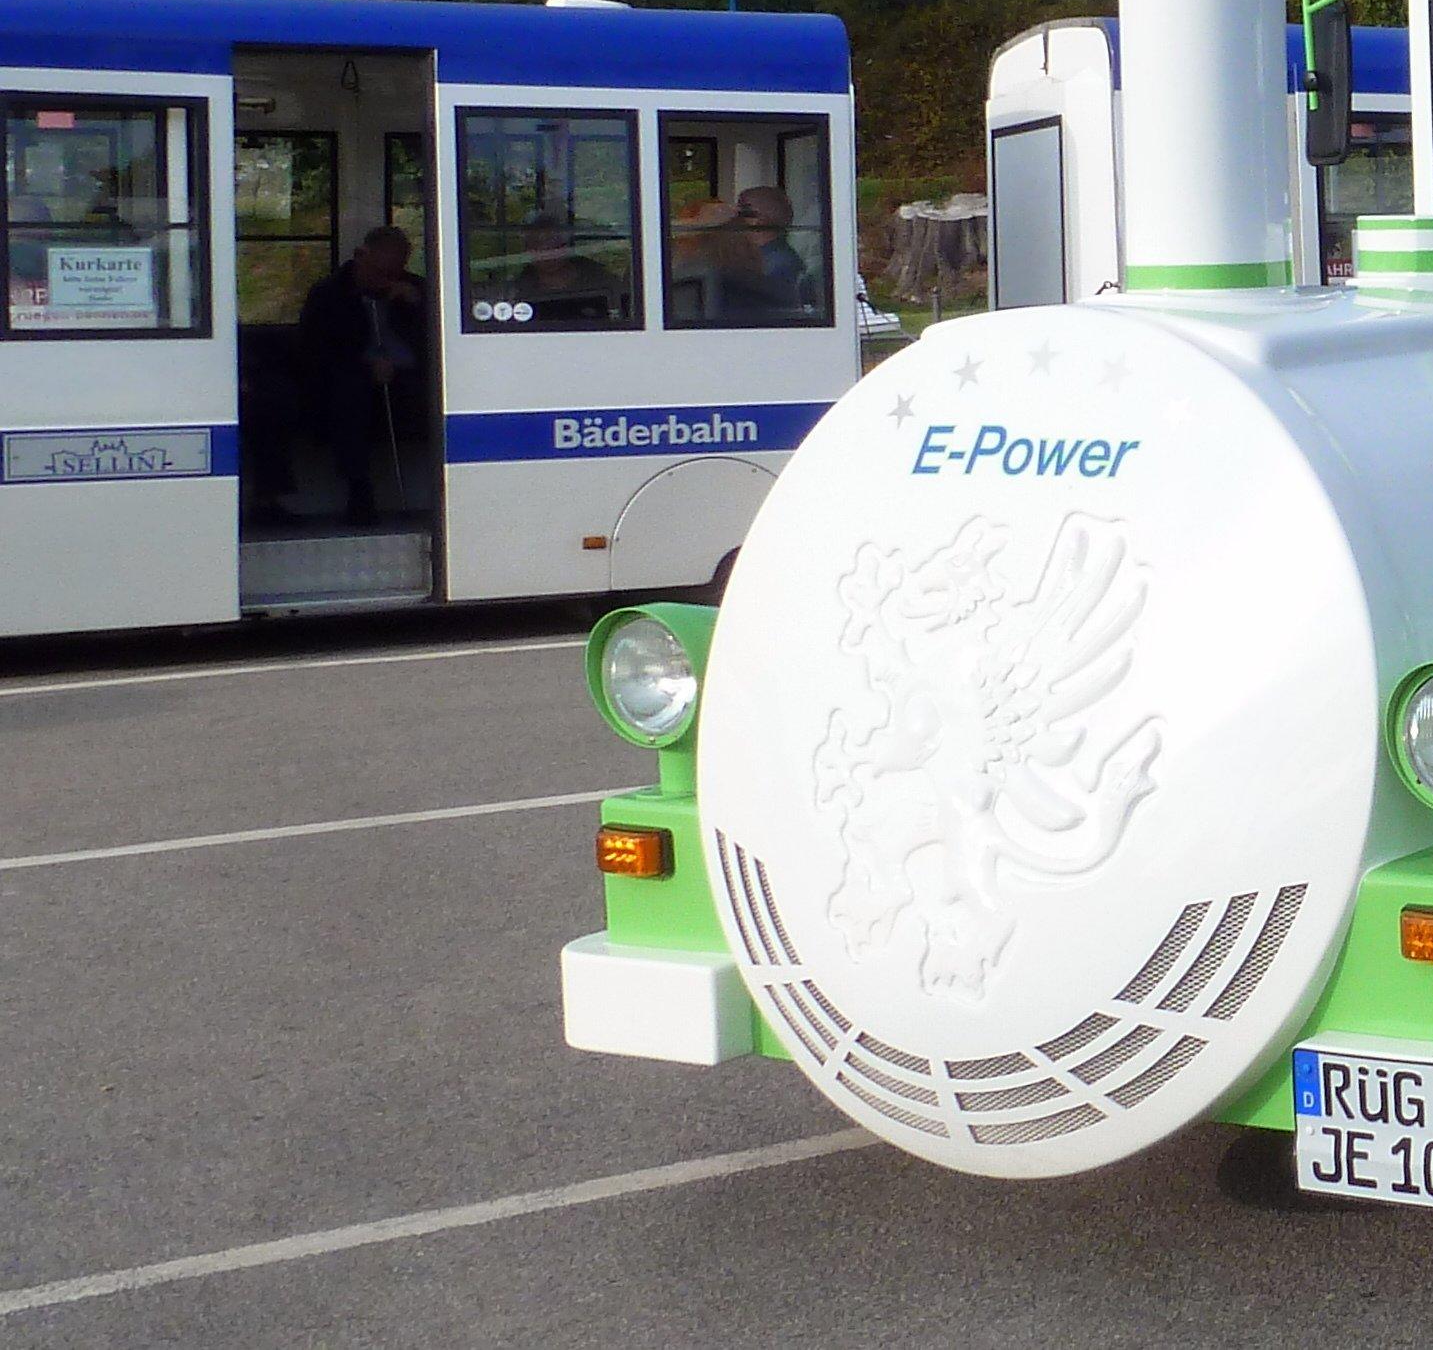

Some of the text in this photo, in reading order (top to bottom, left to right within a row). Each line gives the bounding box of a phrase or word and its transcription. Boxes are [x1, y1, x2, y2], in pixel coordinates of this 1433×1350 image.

[60, 256, 142, 271] Kurkarte
[554, 413, 758, 450] Bäderbahn
[62, 454, 157, 476] SELLIN
[911, 424, 1142, 479] E-Power
[1303, 1090, 1315, 1108] D
[1312, 1127, 1378, 1190] JE
